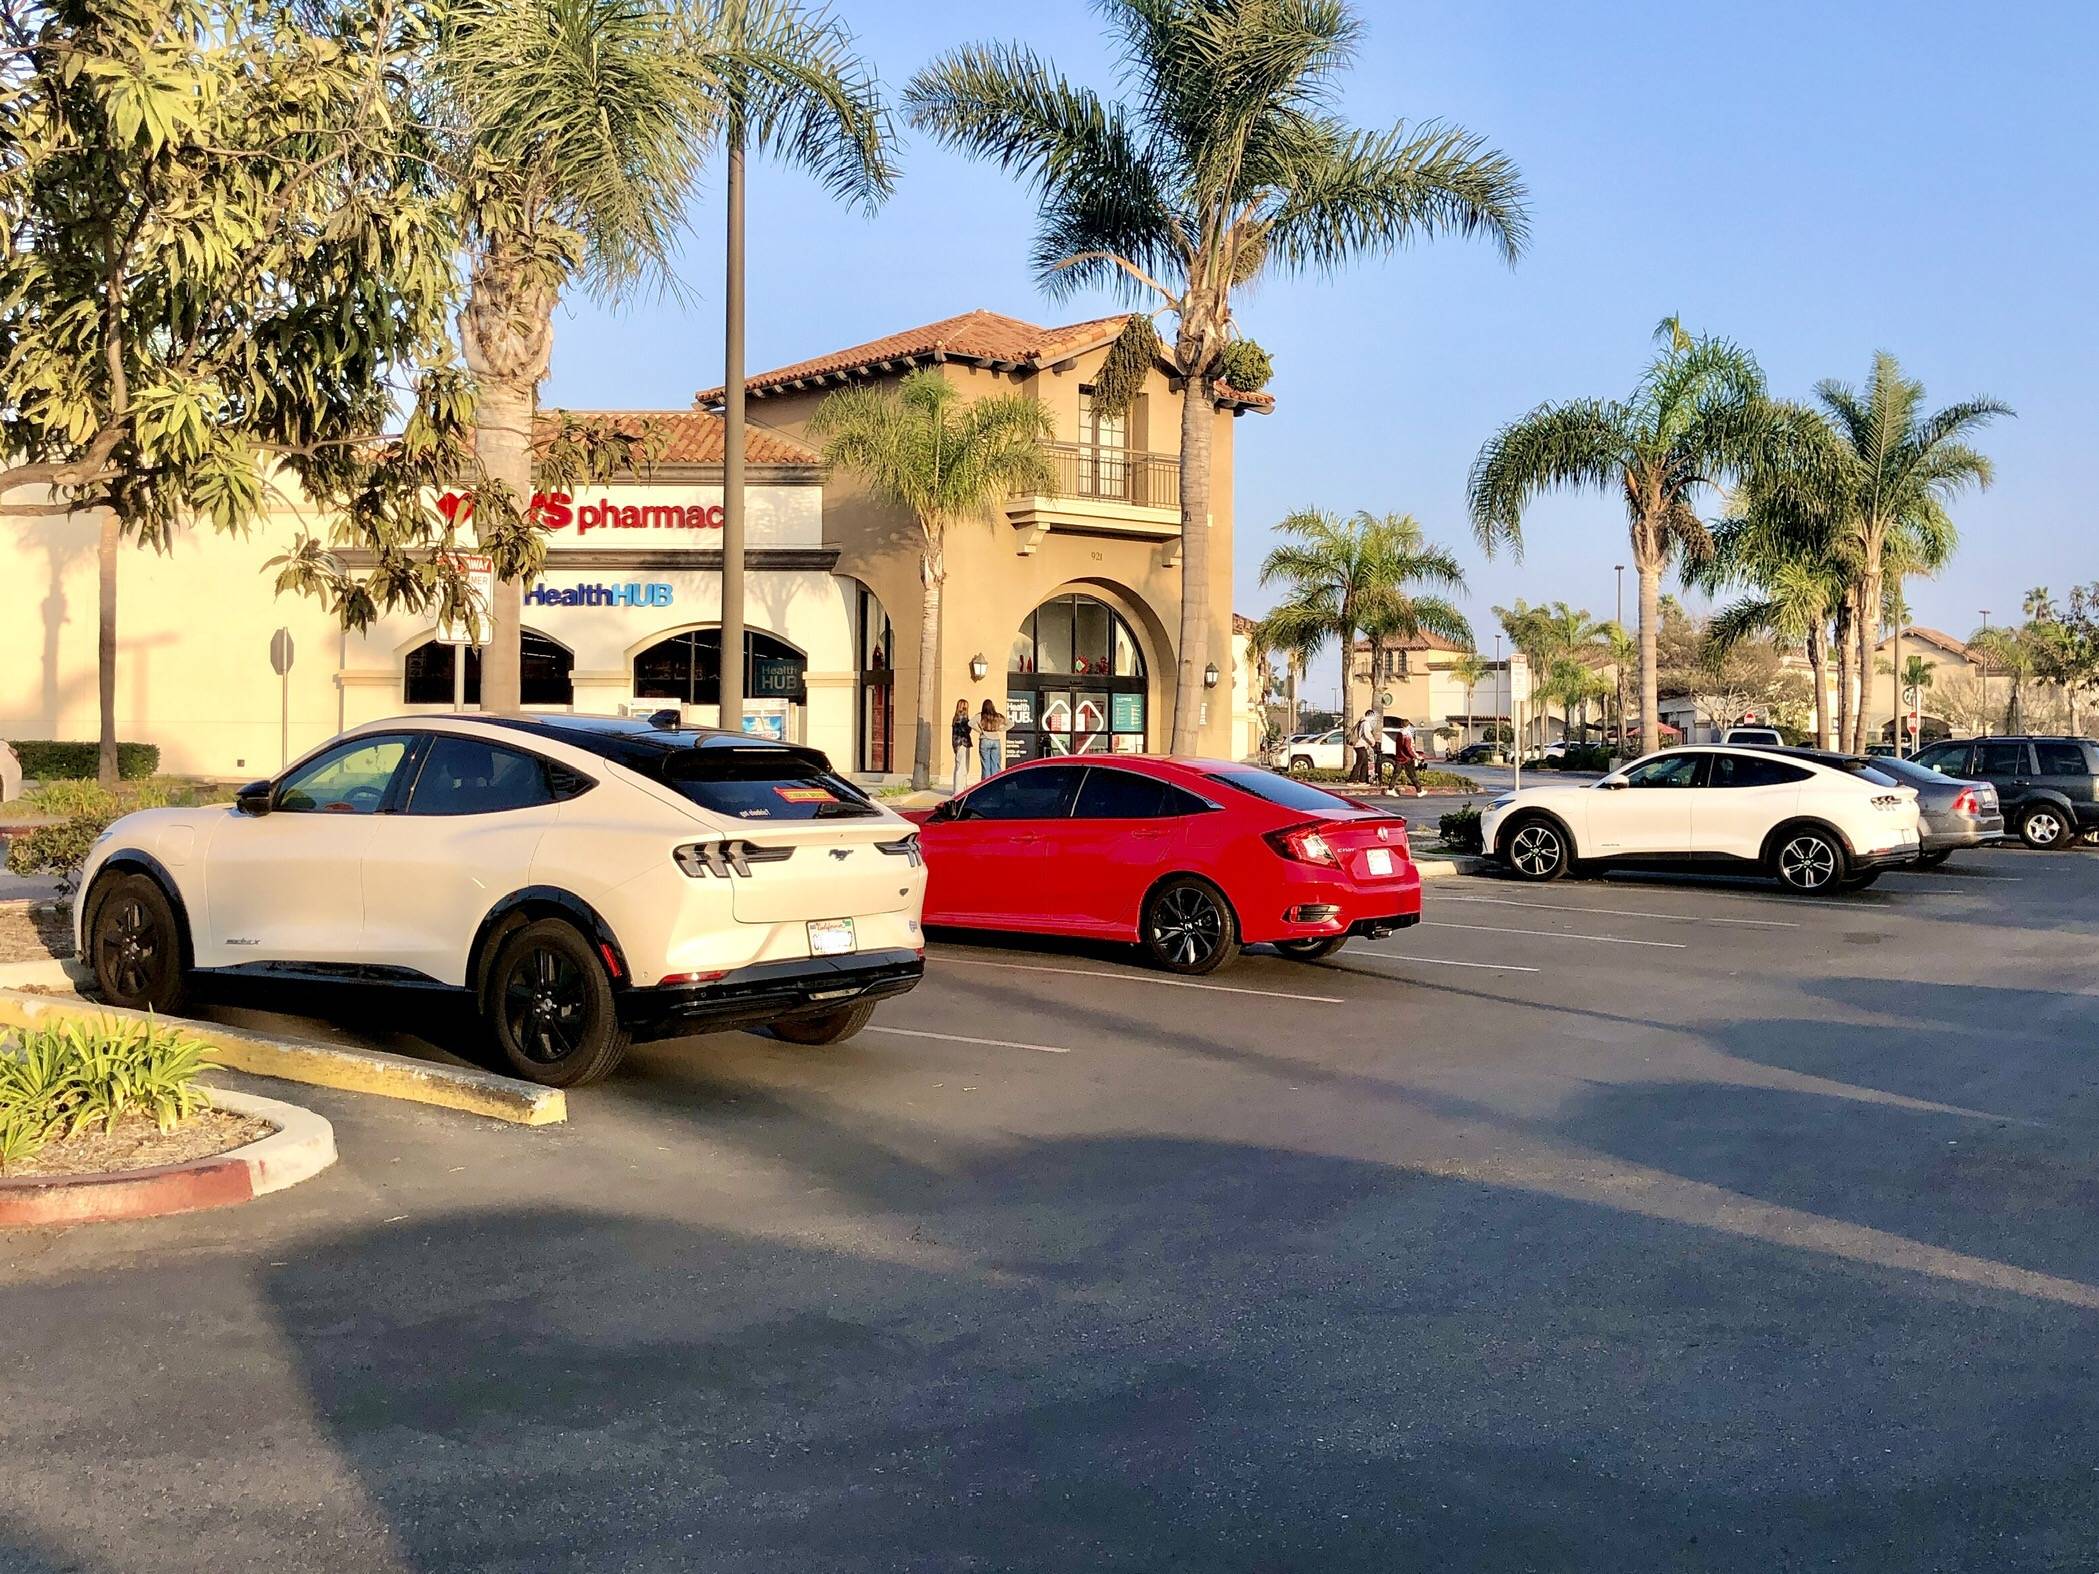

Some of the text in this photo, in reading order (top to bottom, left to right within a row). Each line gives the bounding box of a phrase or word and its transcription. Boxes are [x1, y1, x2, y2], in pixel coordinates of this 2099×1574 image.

[576, 498, 725, 536] pharmac
[1091, 551, 1103, 561] 921
[523, 583, 673, 607] HealthHUB
[762, 675, 798, 690] HUB
[1007, 702, 1030, 711] Health
